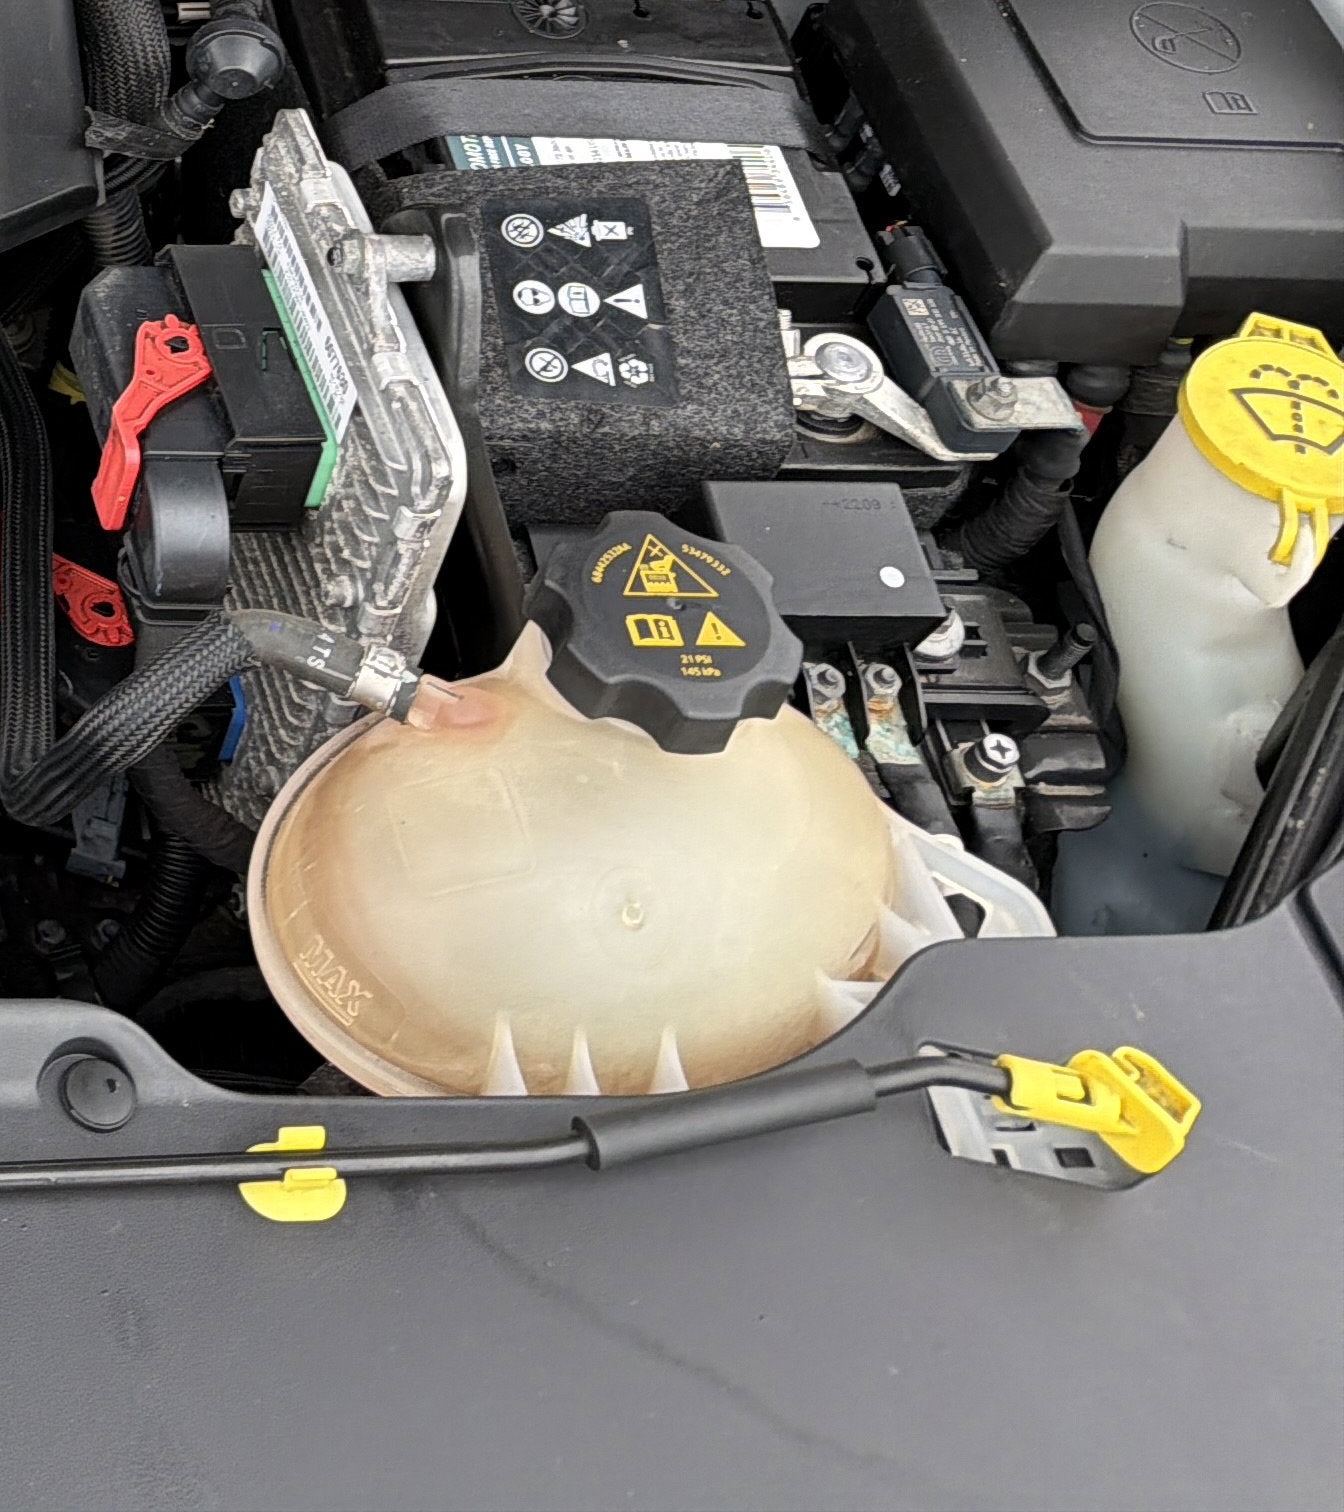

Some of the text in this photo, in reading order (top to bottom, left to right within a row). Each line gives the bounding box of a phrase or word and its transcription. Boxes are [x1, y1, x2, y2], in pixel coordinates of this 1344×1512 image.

[680, 654, 694, 664] 21
[680, 666, 702, 677] 145
[299, 934, 374, 1018] MAX
